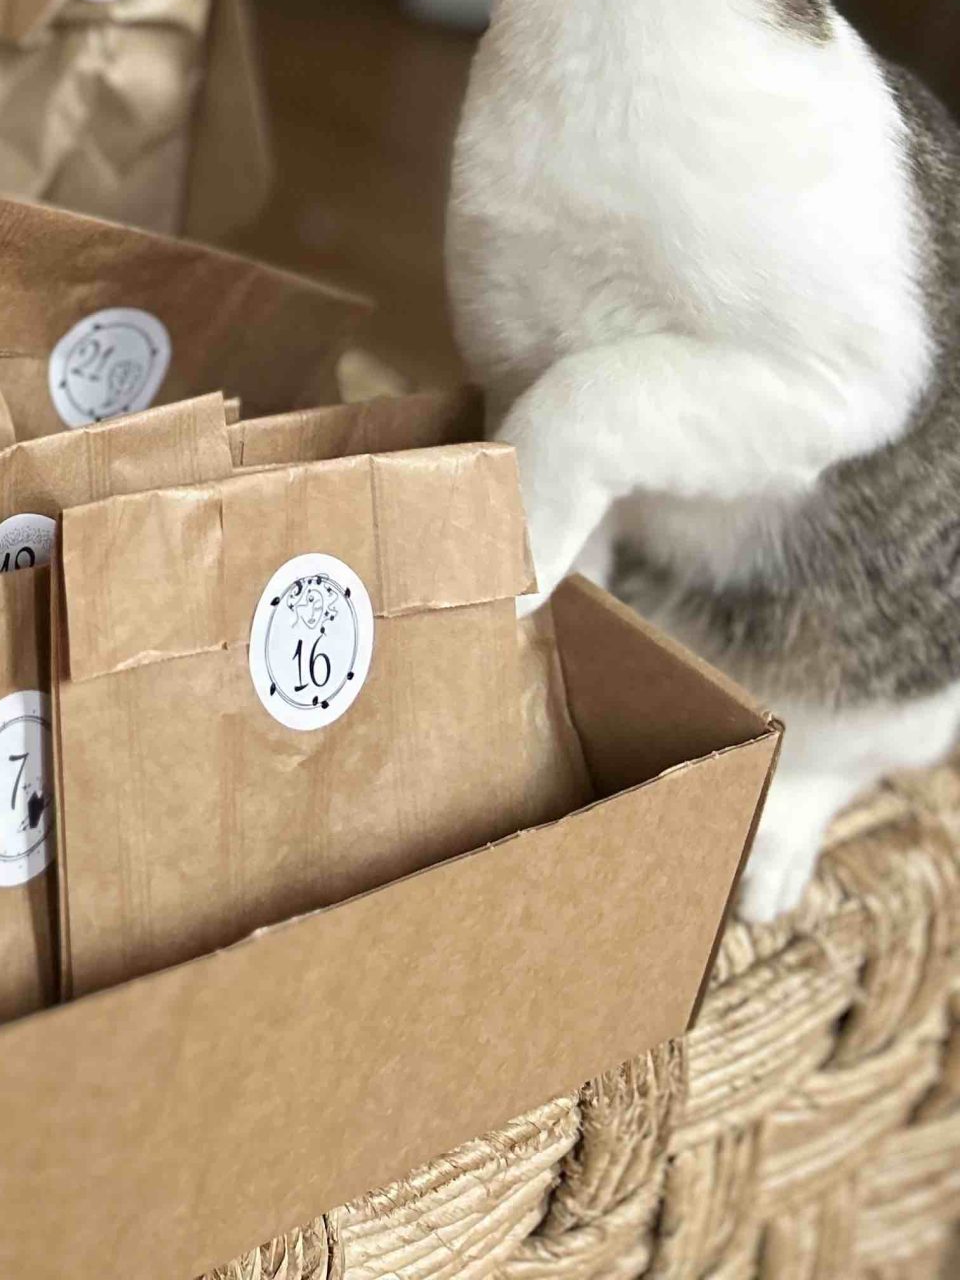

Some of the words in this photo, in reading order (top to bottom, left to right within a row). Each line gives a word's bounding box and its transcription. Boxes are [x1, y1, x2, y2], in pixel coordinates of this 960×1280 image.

[71, 338, 115, 383] 21
[292, 633, 331, 693] 16
[8, 746, 30, 811] 7
